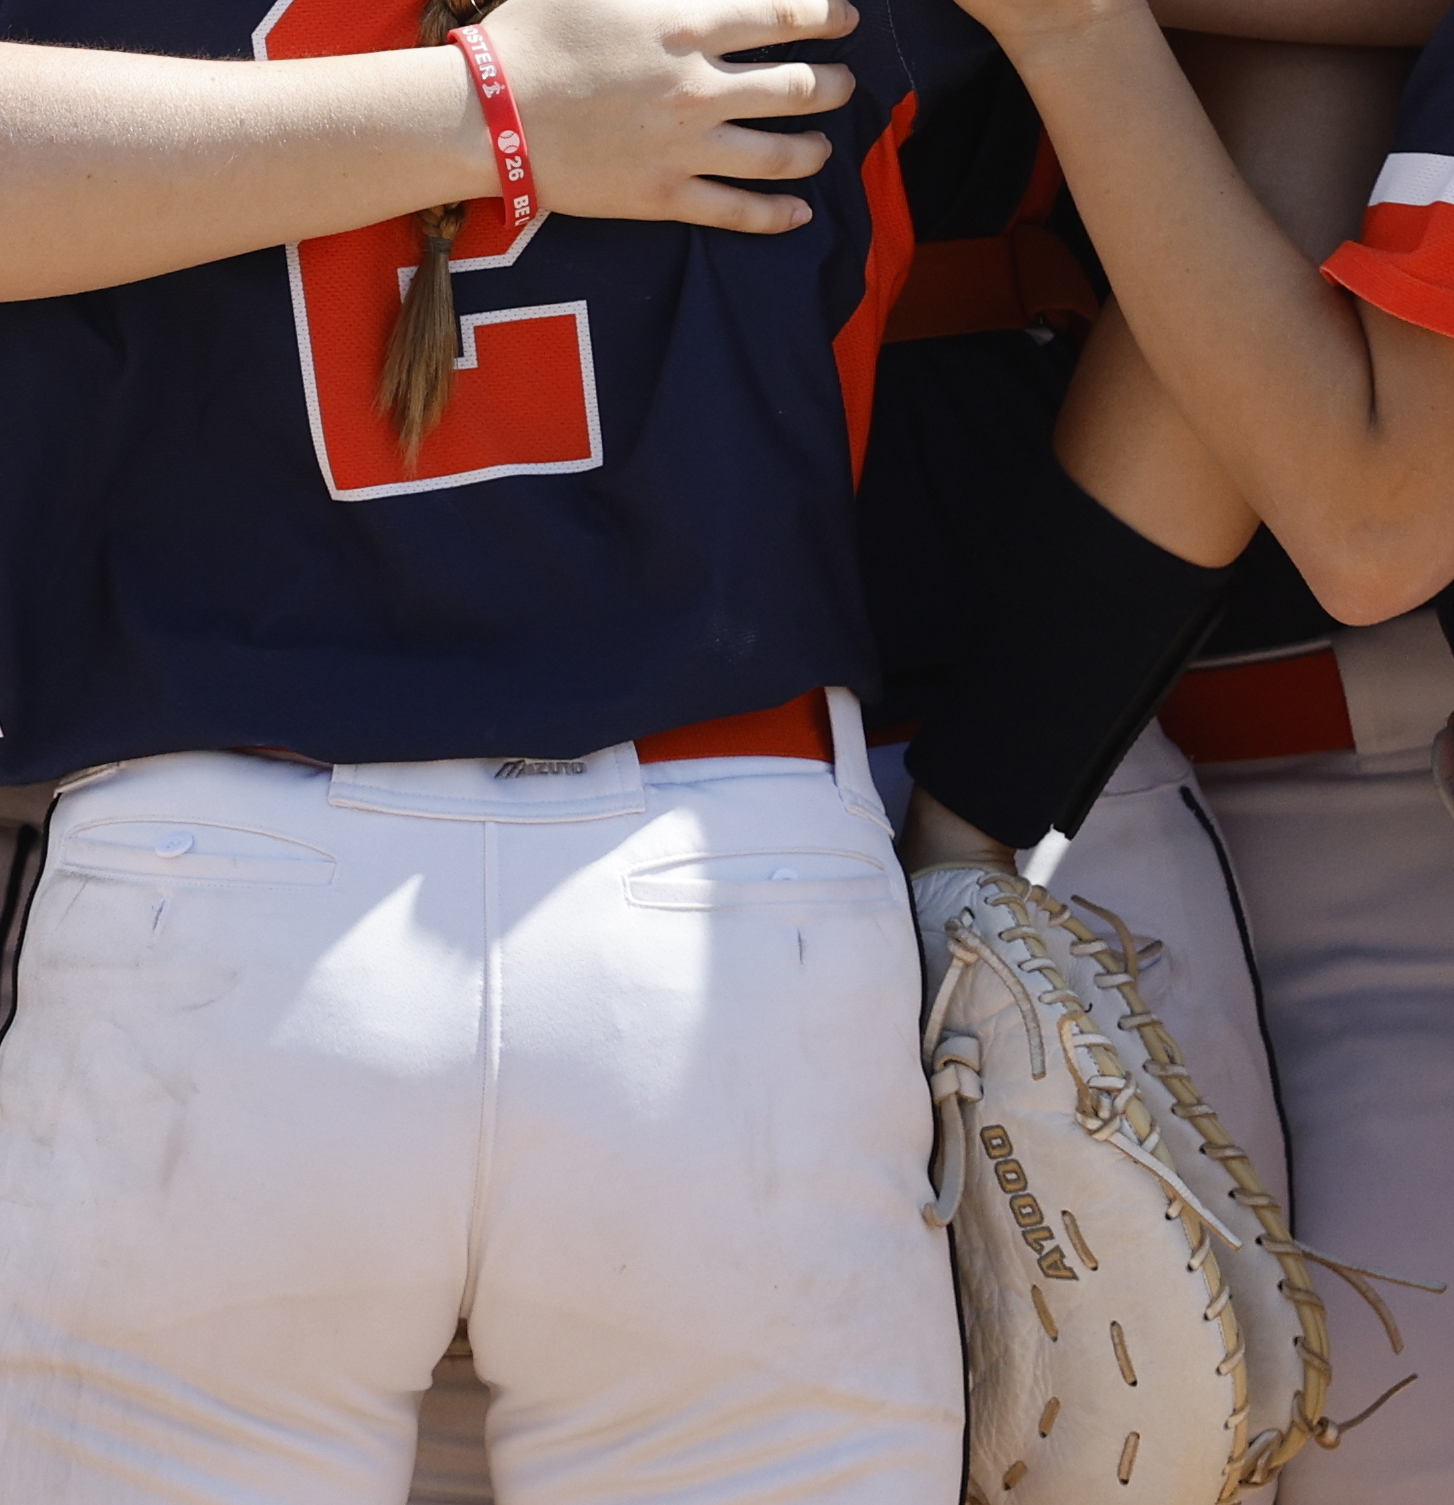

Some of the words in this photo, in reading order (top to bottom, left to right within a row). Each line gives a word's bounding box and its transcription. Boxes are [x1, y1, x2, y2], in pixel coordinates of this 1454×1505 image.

[462, 24, 498, 81] OSTER
[505, 155, 525, 182] 26
[979, 1123, 1080, 1281] A1000
